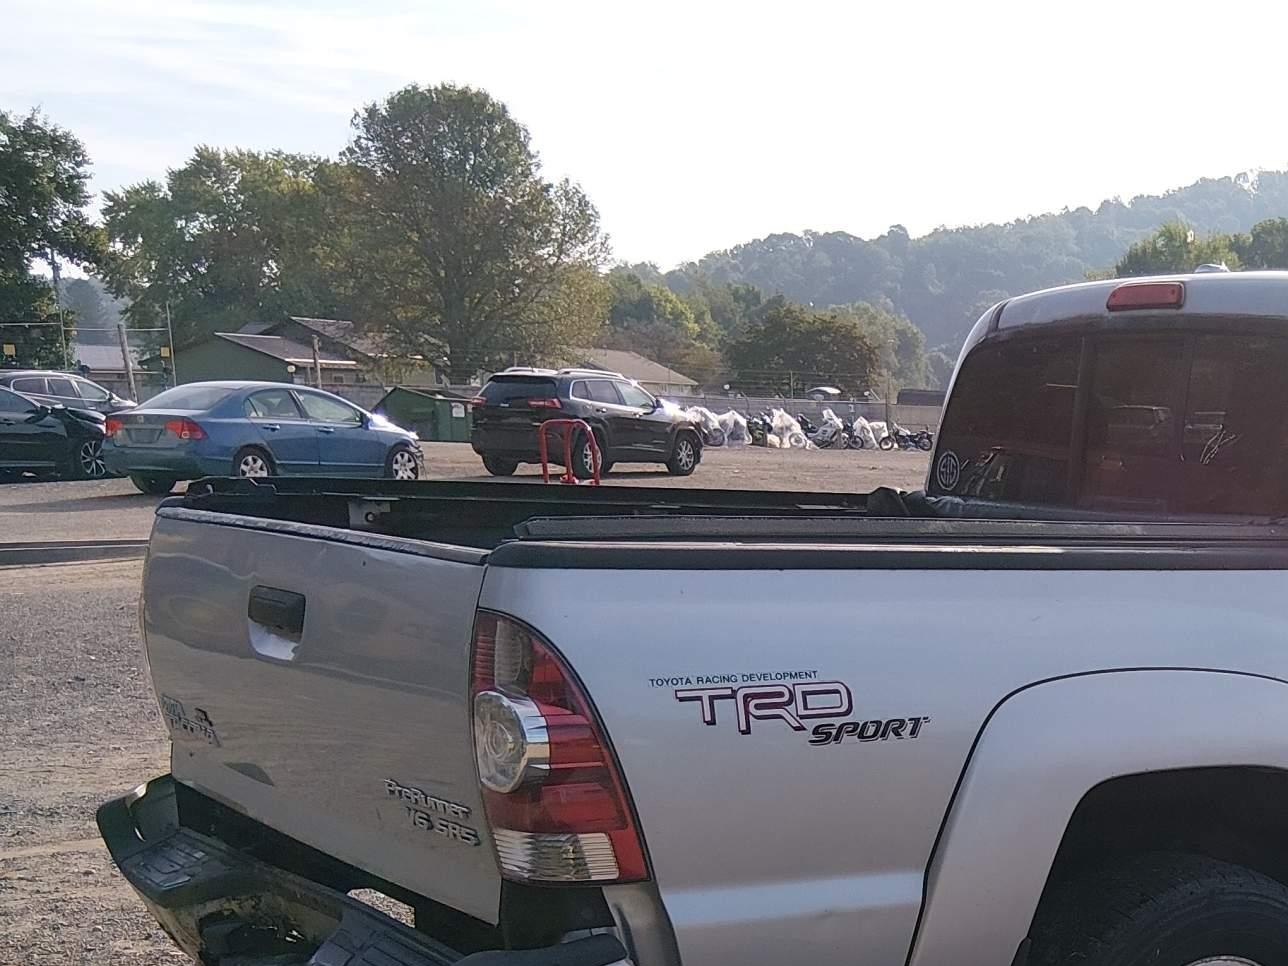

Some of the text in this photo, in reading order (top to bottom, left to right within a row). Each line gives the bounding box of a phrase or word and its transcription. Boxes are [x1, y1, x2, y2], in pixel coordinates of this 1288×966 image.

[648, 670, 819, 687] TOYOTA RACING DEVELOPMENT
[674, 681, 855, 735] TRD
[808, 716, 931, 746] SPORT
